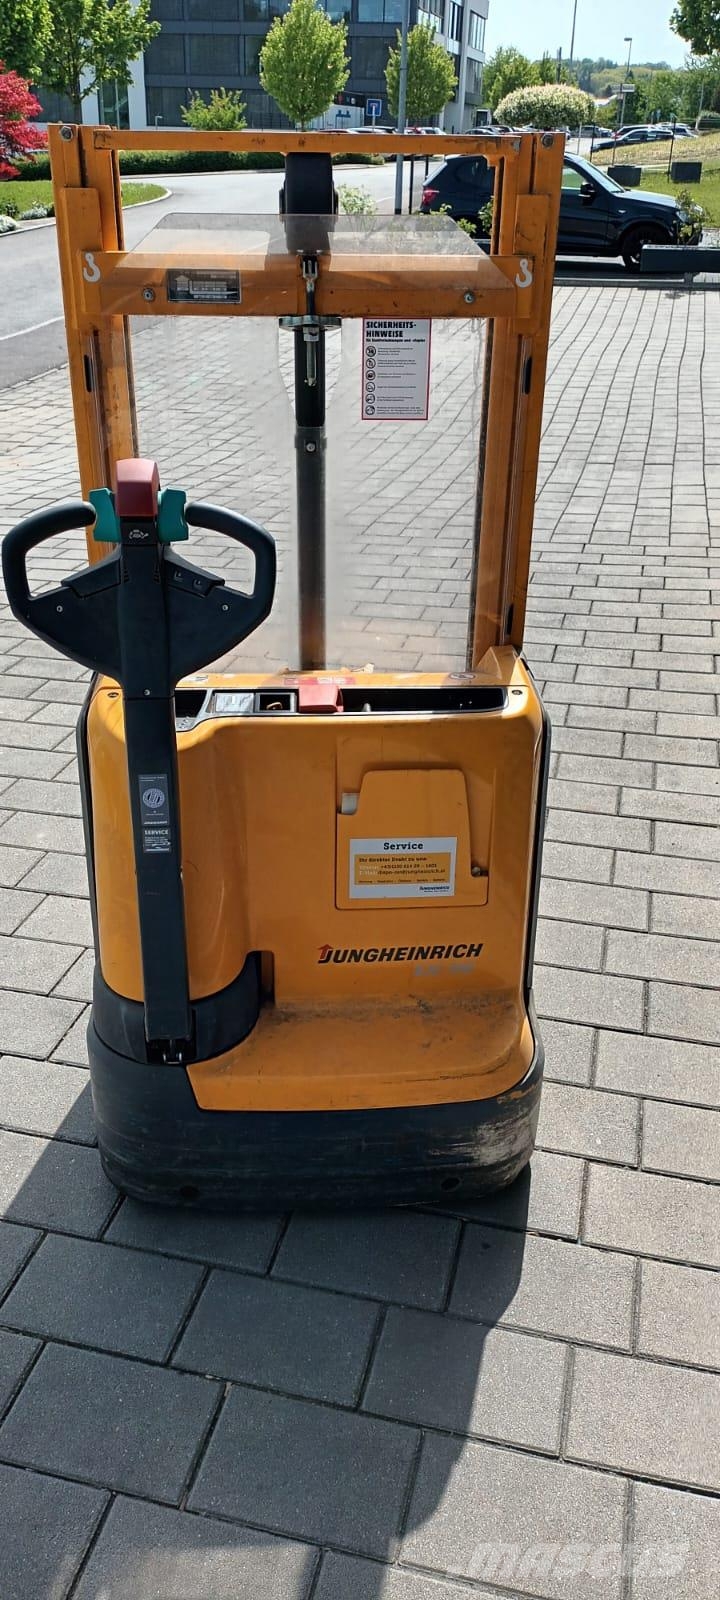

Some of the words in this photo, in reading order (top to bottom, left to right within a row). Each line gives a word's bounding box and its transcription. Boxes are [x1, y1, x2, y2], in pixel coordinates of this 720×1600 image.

[366, 321, 417, 329] SICHERHEITS-
[383, 842, 424, 850] Service
[317, 943, 483, 964] JUNGHEINRICH
